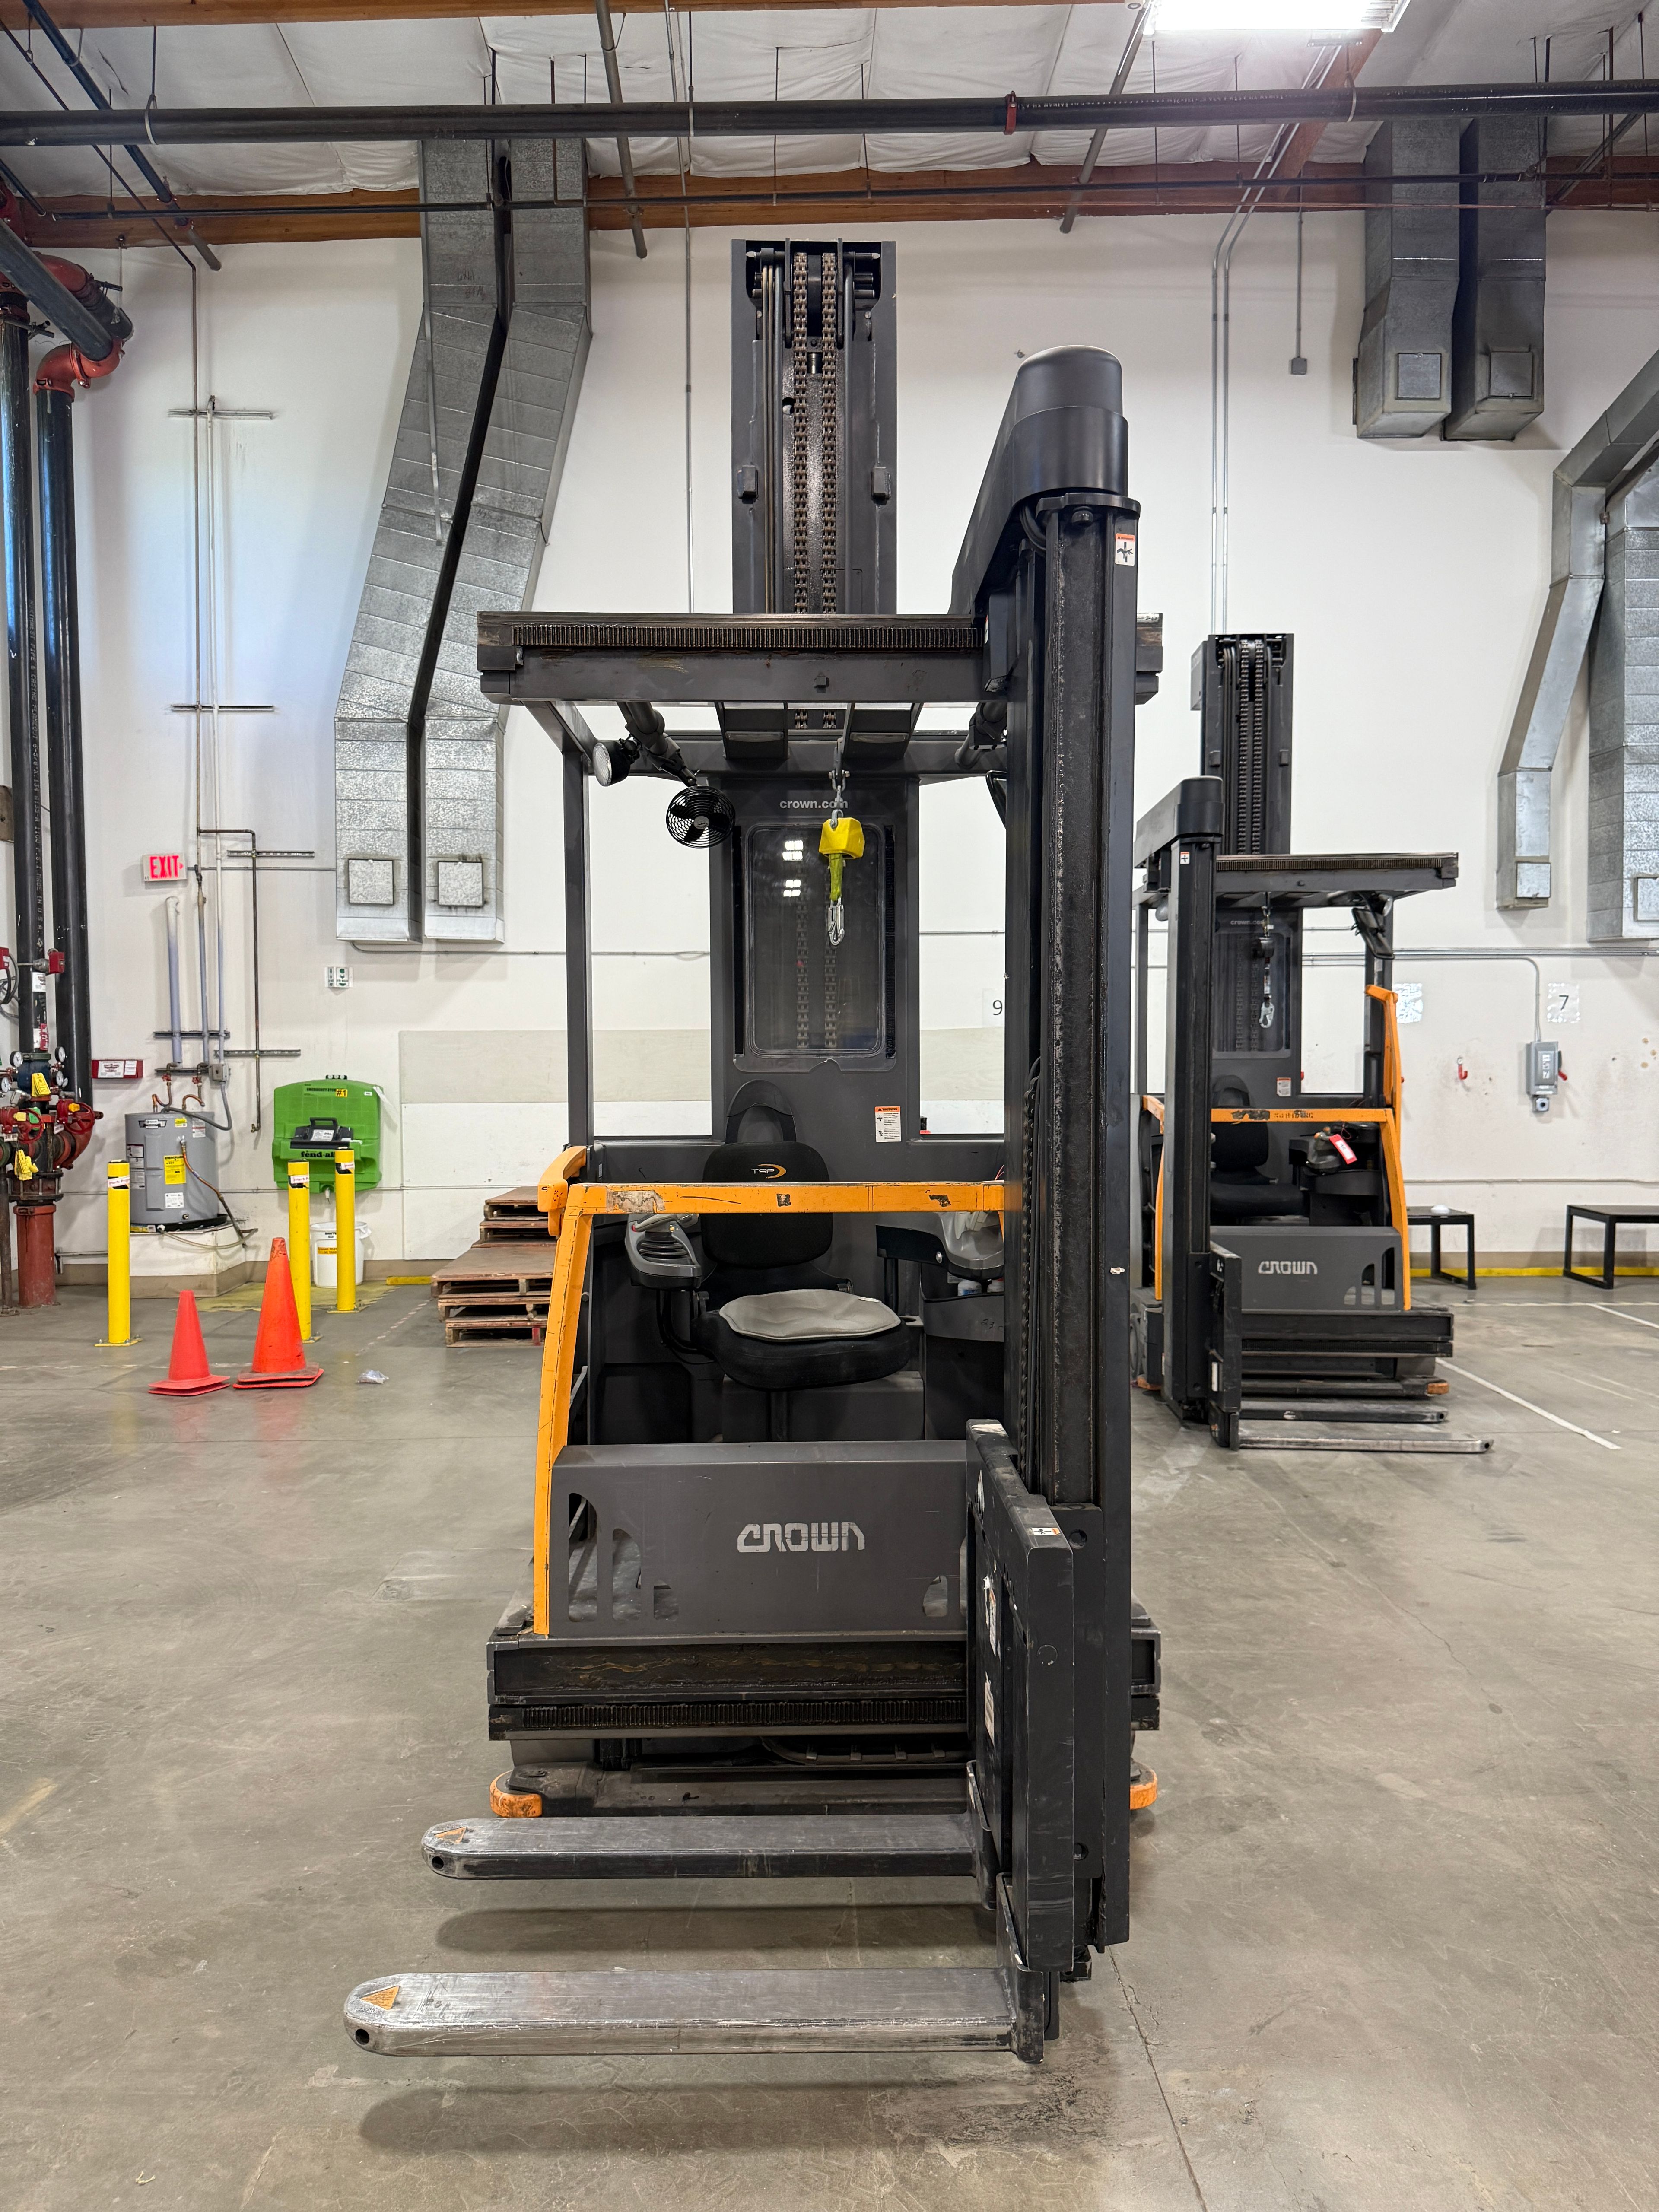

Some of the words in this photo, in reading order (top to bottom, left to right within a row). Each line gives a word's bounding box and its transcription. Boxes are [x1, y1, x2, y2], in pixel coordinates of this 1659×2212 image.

[150, 855, 179, 879] EXIT
[993, 1000, 1002, 1015] 9
[1558, 995, 1569, 1011] 7
[1258, 1261, 1318, 1274] CROWN
[737, 1522, 865, 1553] CROWN
